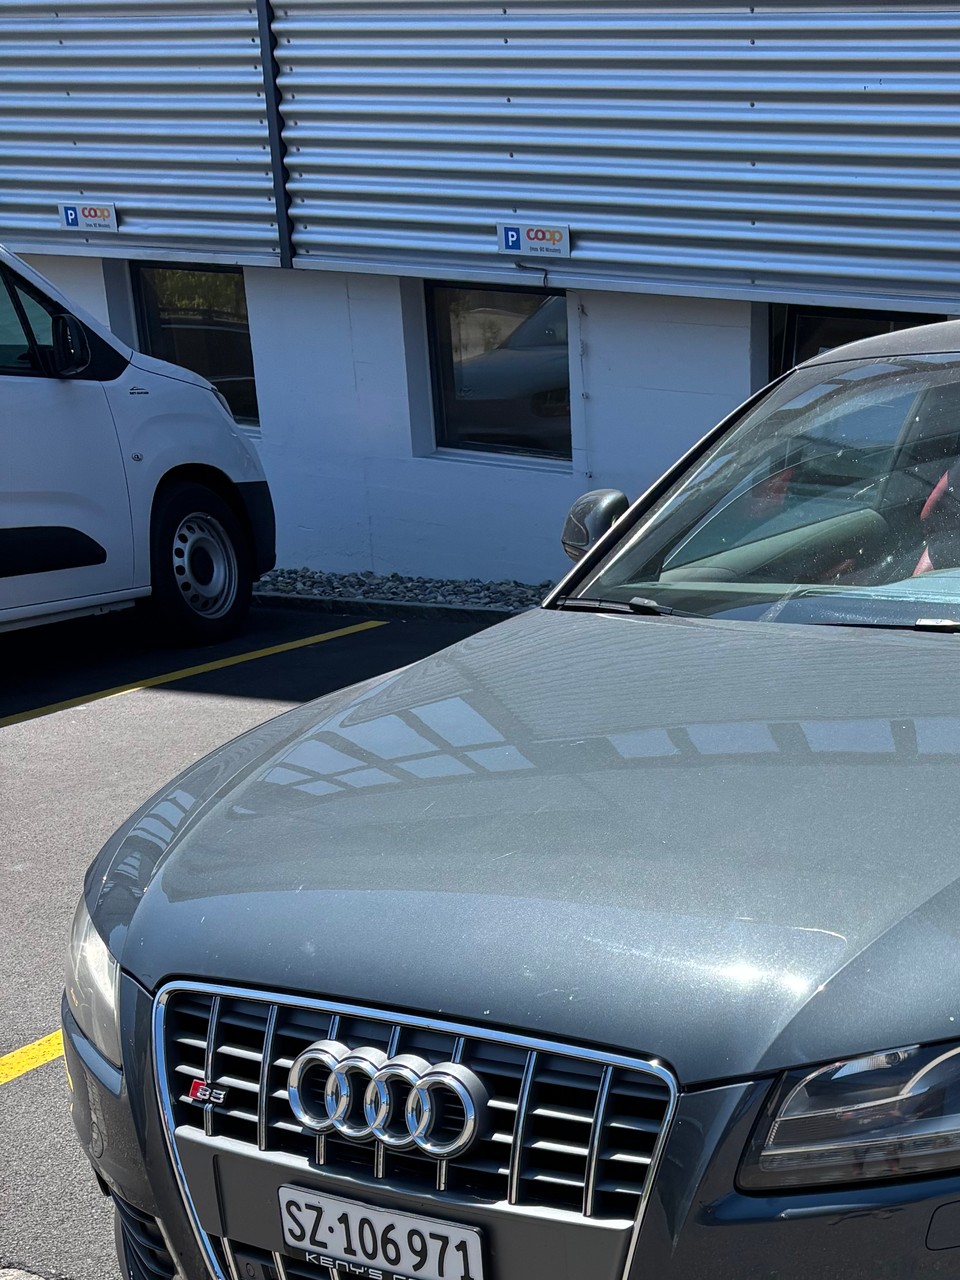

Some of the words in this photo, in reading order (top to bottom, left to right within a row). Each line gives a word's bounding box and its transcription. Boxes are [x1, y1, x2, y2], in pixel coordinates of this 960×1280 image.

[67, 209, 75, 224] P
[81, 207, 111, 221] coop
[508, 231, 517, 246] P
[526, 228, 563, 245] coop
[305, 1251, 383, 1280] KENY'S
